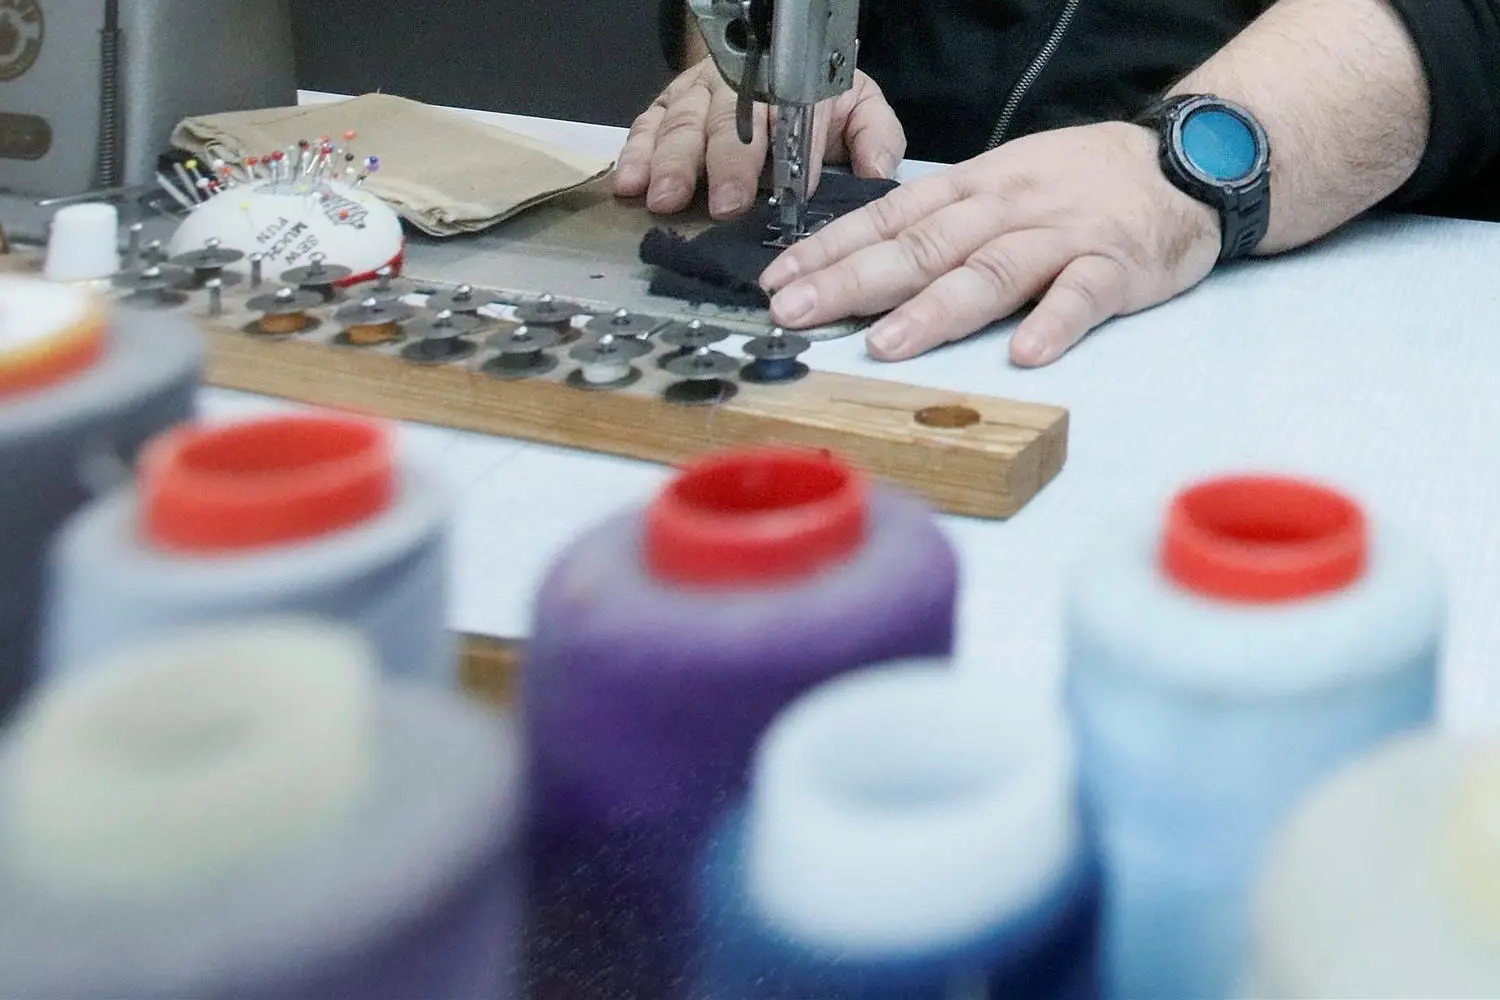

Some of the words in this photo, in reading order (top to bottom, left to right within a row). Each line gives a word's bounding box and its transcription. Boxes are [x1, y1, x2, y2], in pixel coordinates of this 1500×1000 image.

[256, 216, 288, 244] FUN
[262, 221, 308, 261] MUCH
[285, 233, 319, 265] SEW
